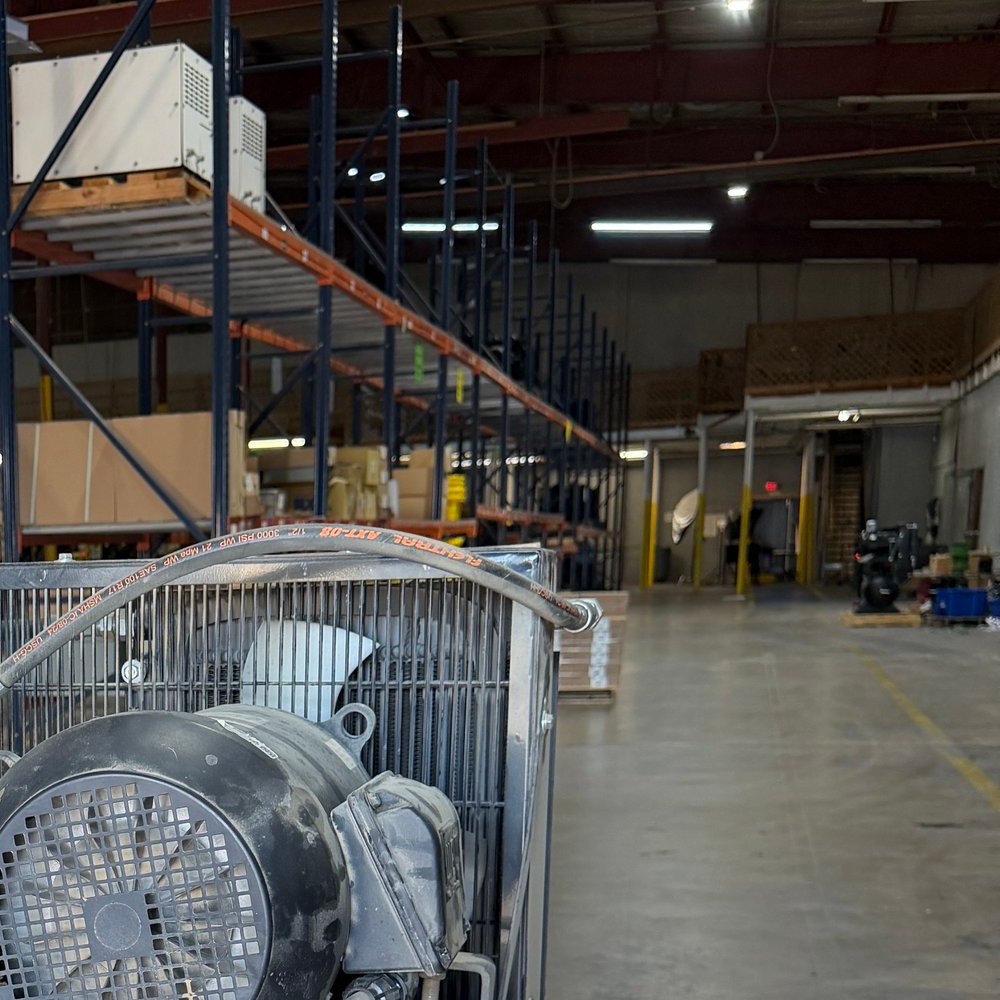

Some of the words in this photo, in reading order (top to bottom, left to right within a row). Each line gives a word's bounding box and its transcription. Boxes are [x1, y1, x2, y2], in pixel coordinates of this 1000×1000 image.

[238, 533, 255, 544] PSI
[257, 529, 280, 540] 3000
[201, 542, 212, 553] 21
[219, 537, 236, 548] WP
[163, 556, 179, 567] WP
[107, 583, 125, 596] R17
